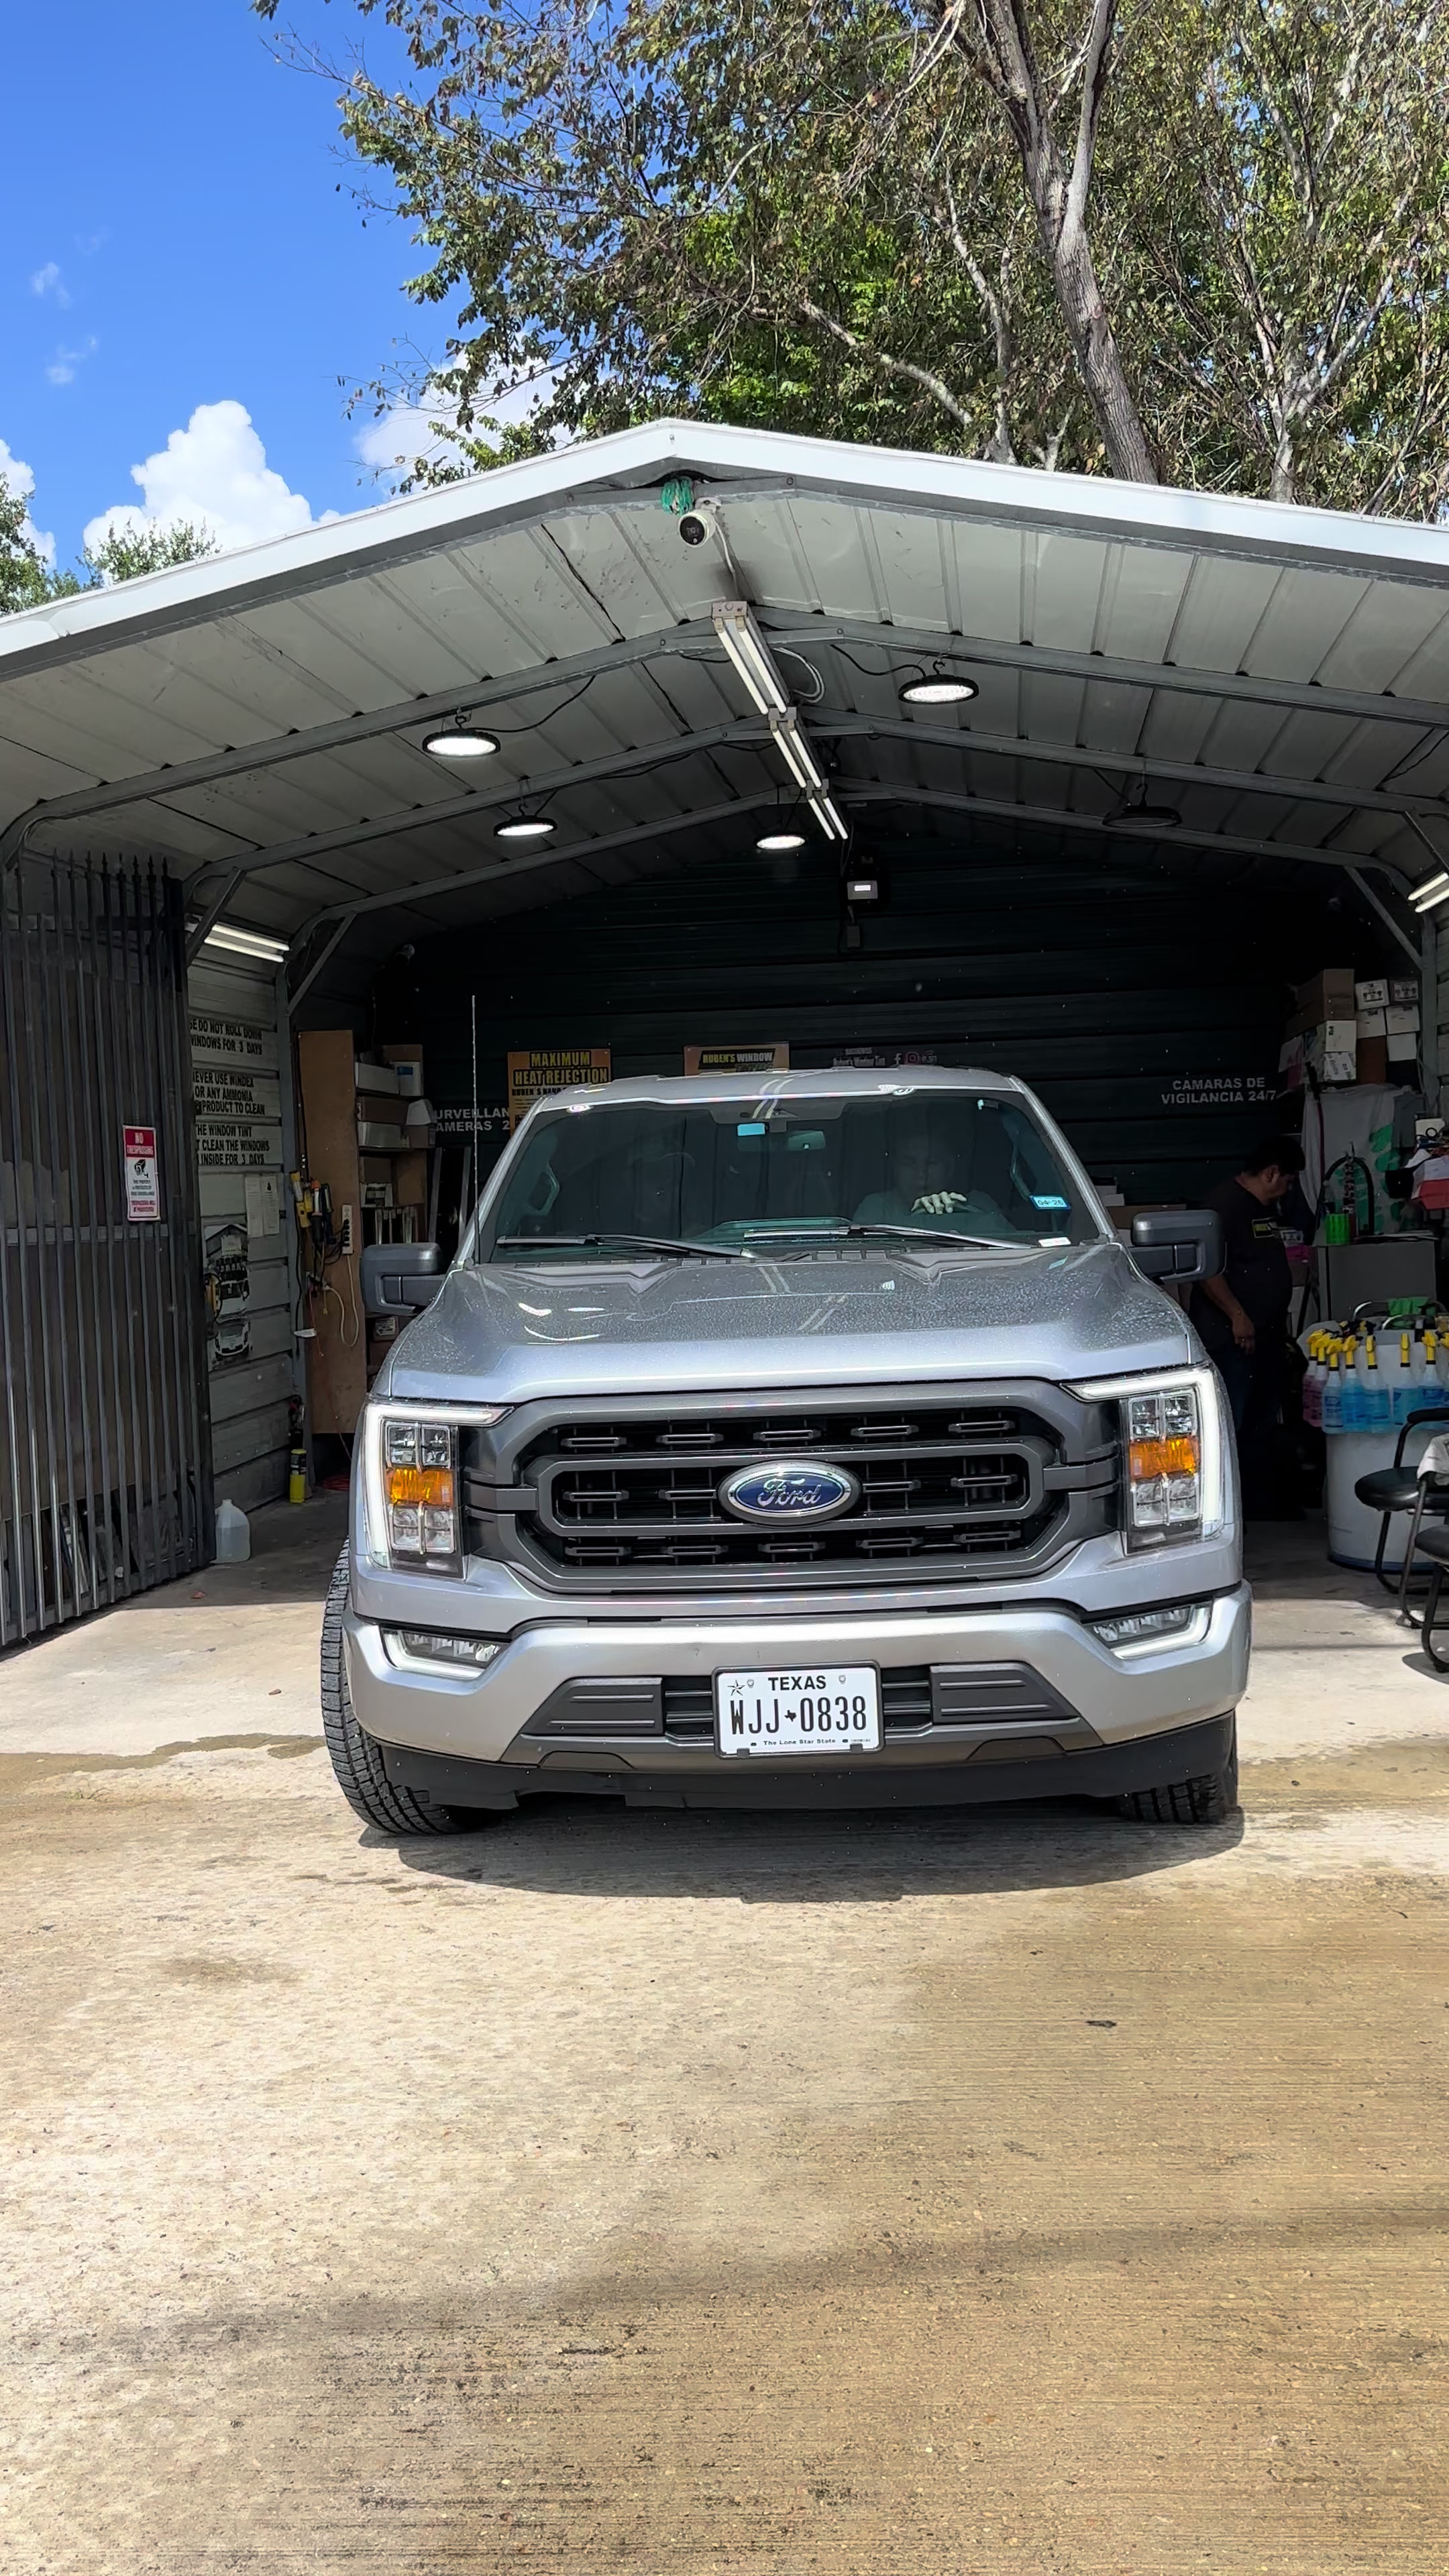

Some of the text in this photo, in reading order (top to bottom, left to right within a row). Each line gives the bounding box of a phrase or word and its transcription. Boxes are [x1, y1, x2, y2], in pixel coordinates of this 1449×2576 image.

[210, 1022, 223, 1034] NOT
[223, 1038, 236, 1053] FOR
[239, 1041, 244, 1053] 3
[531, 1051, 590, 1067] MAXIMUM
[737, 1052, 773, 1063] WINDOW
[215, 1073, 227, 1085] USE
[515, 1069, 608, 1085] HEAT REJECTION
[1173, 1077, 1266, 1091] CAMARAS DE
[195, 1085, 205, 1098] OR
[207, 1087, 221, 1099] ANY
[1161, 1089, 1277, 1105] VIGILANCIA 24/7
[203, 1101, 233, 1113] PRODUCT
[234, 1102, 244, 1113] TO
[245, 1103, 265, 1115] CLEAN
[435, 1107, 510, 1120] URVEILLAN
[237, 1125, 252, 1137] TINT
[435, 1120, 492, 1132] AMERAS
[135, 1132, 144, 1144] NO
[202, 1140, 225, 1151] CLEAN
[226, 1140, 239, 1151] THE
[201, 1153, 224, 1165] INSIDE
[225, 1154, 238, 1165] FOR
[241, 1154, 246, 1165] 3
[757, 1478, 821, 1507] Ford
[767, 1675, 826, 1691] TEXAS
[730, 1696, 867, 1735] WJJ 0838
